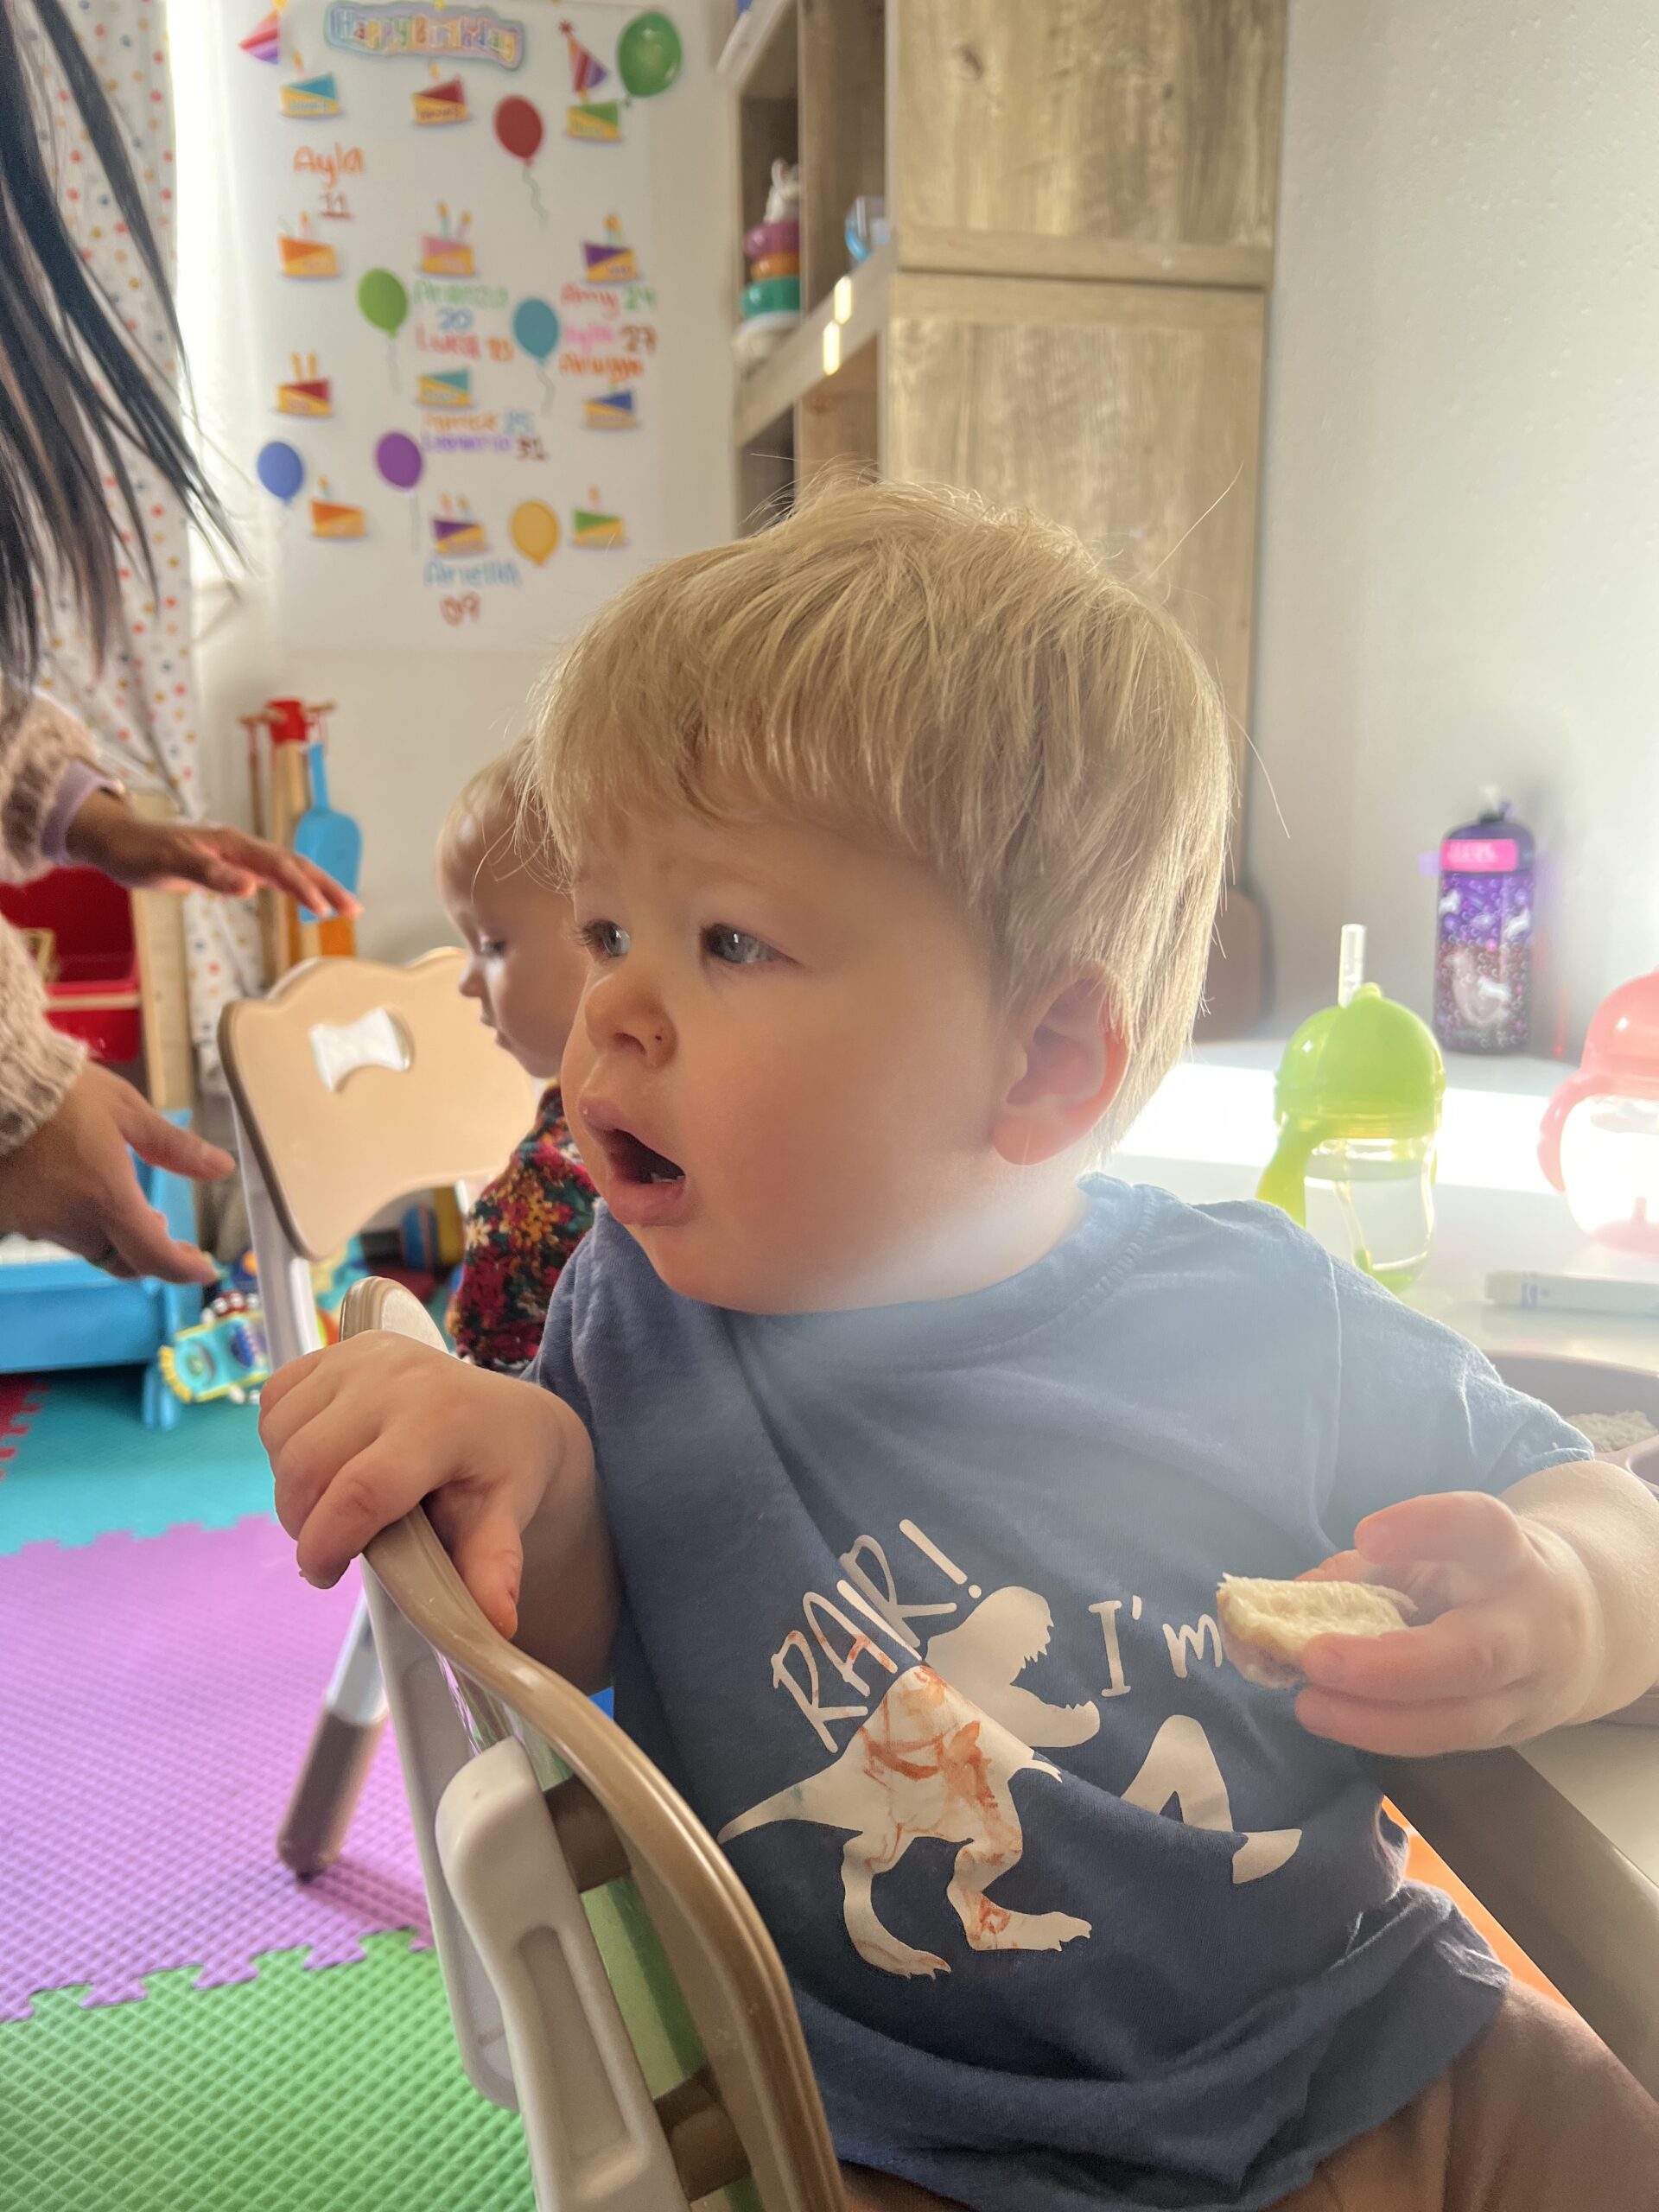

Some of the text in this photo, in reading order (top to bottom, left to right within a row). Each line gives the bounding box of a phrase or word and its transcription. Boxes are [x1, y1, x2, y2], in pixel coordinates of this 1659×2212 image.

[330, 6, 518, 63] Happy Birthday
[294, 142, 365, 189] Ayla
[437, 308, 474, 332] 20
[1089, 1594, 1224, 1698] I'm
